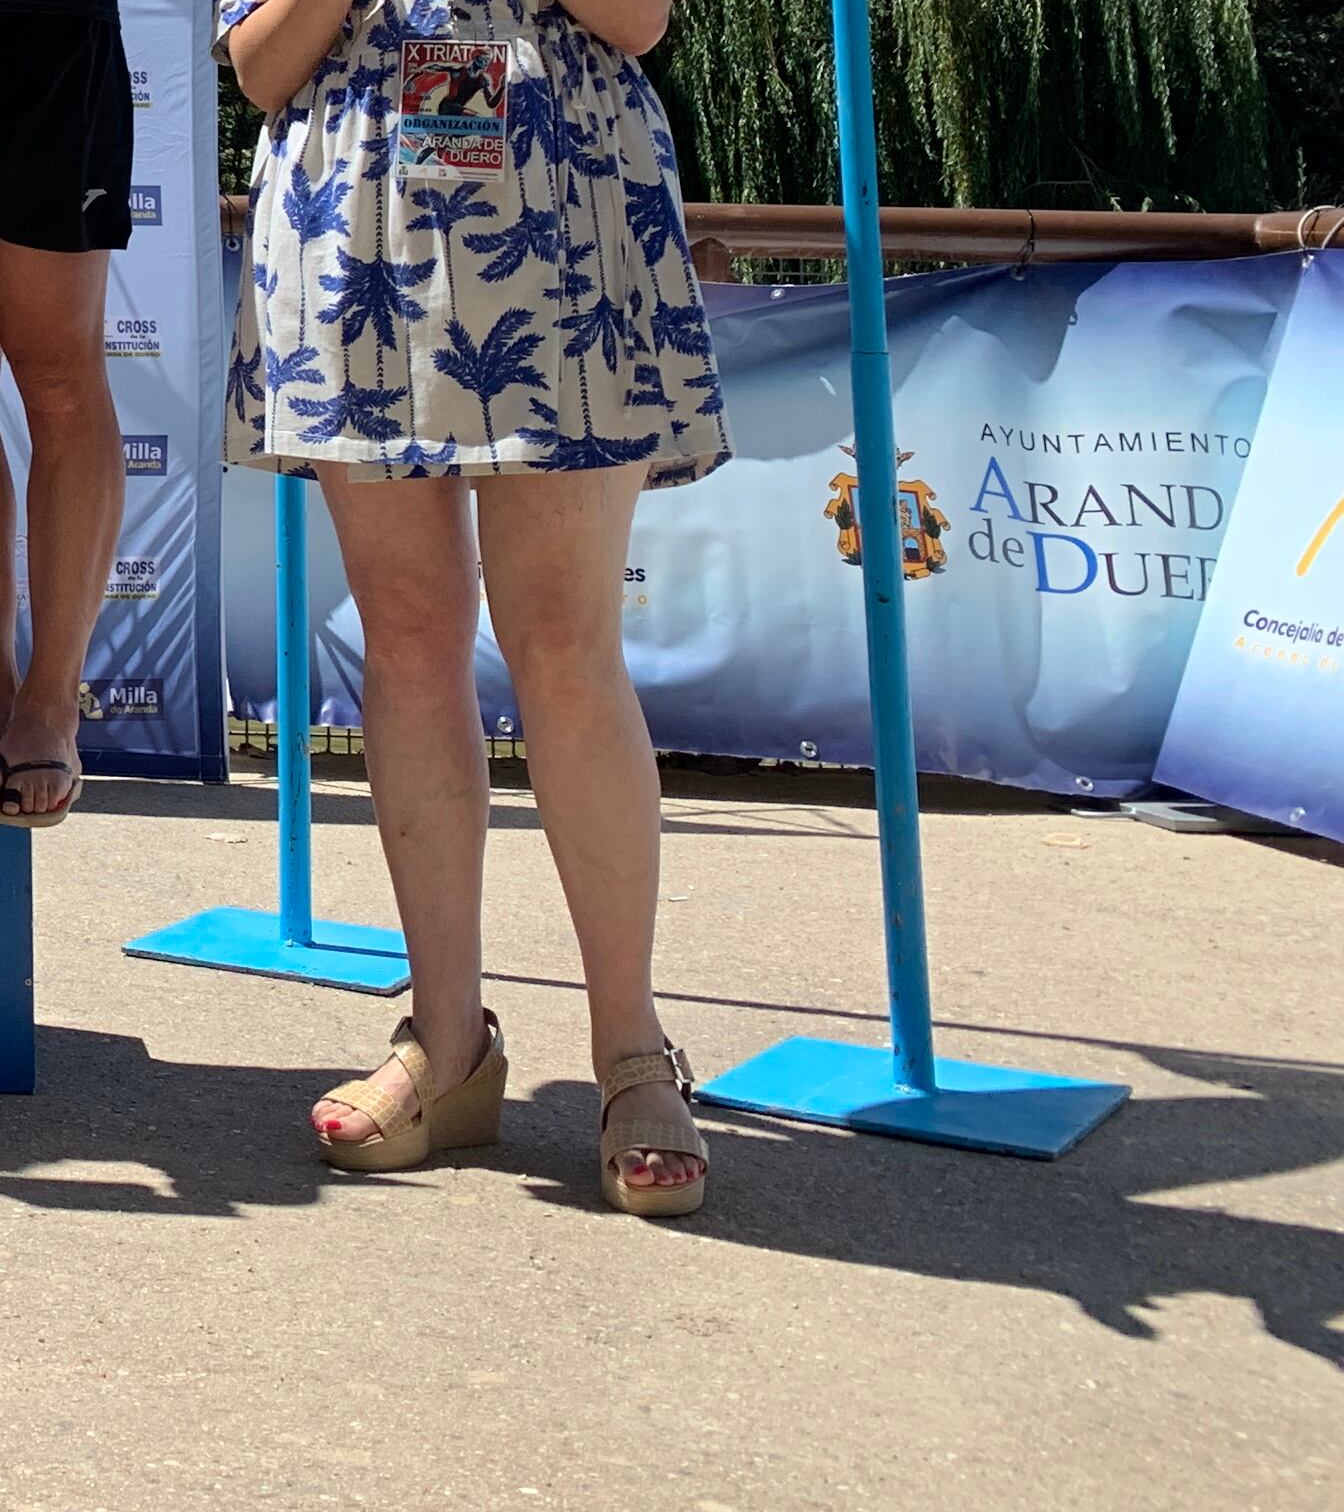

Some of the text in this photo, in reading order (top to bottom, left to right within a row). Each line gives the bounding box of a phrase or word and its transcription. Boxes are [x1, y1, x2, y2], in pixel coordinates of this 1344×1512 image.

[407, 44, 506, 65] X TRIATN
[403, 117, 500, 132] ORGANIZACIÓN
[422, 135, 504, 151] ARANDA DE
[450, 151, 502, 165] DUERO
[129, 192, 156, 210] lla
[116, 319, 157, 335] CROSS
[981, 422, 1252, 459] AYUNTAMIENTO
[969, 456, 1224, 531] ARAND
[968, 519, 1026, 569] de
[116, 559, 155, 576] CROSS
[110, 686, 158, 705] Milla
[124, 704, 159, 715] Aranda
